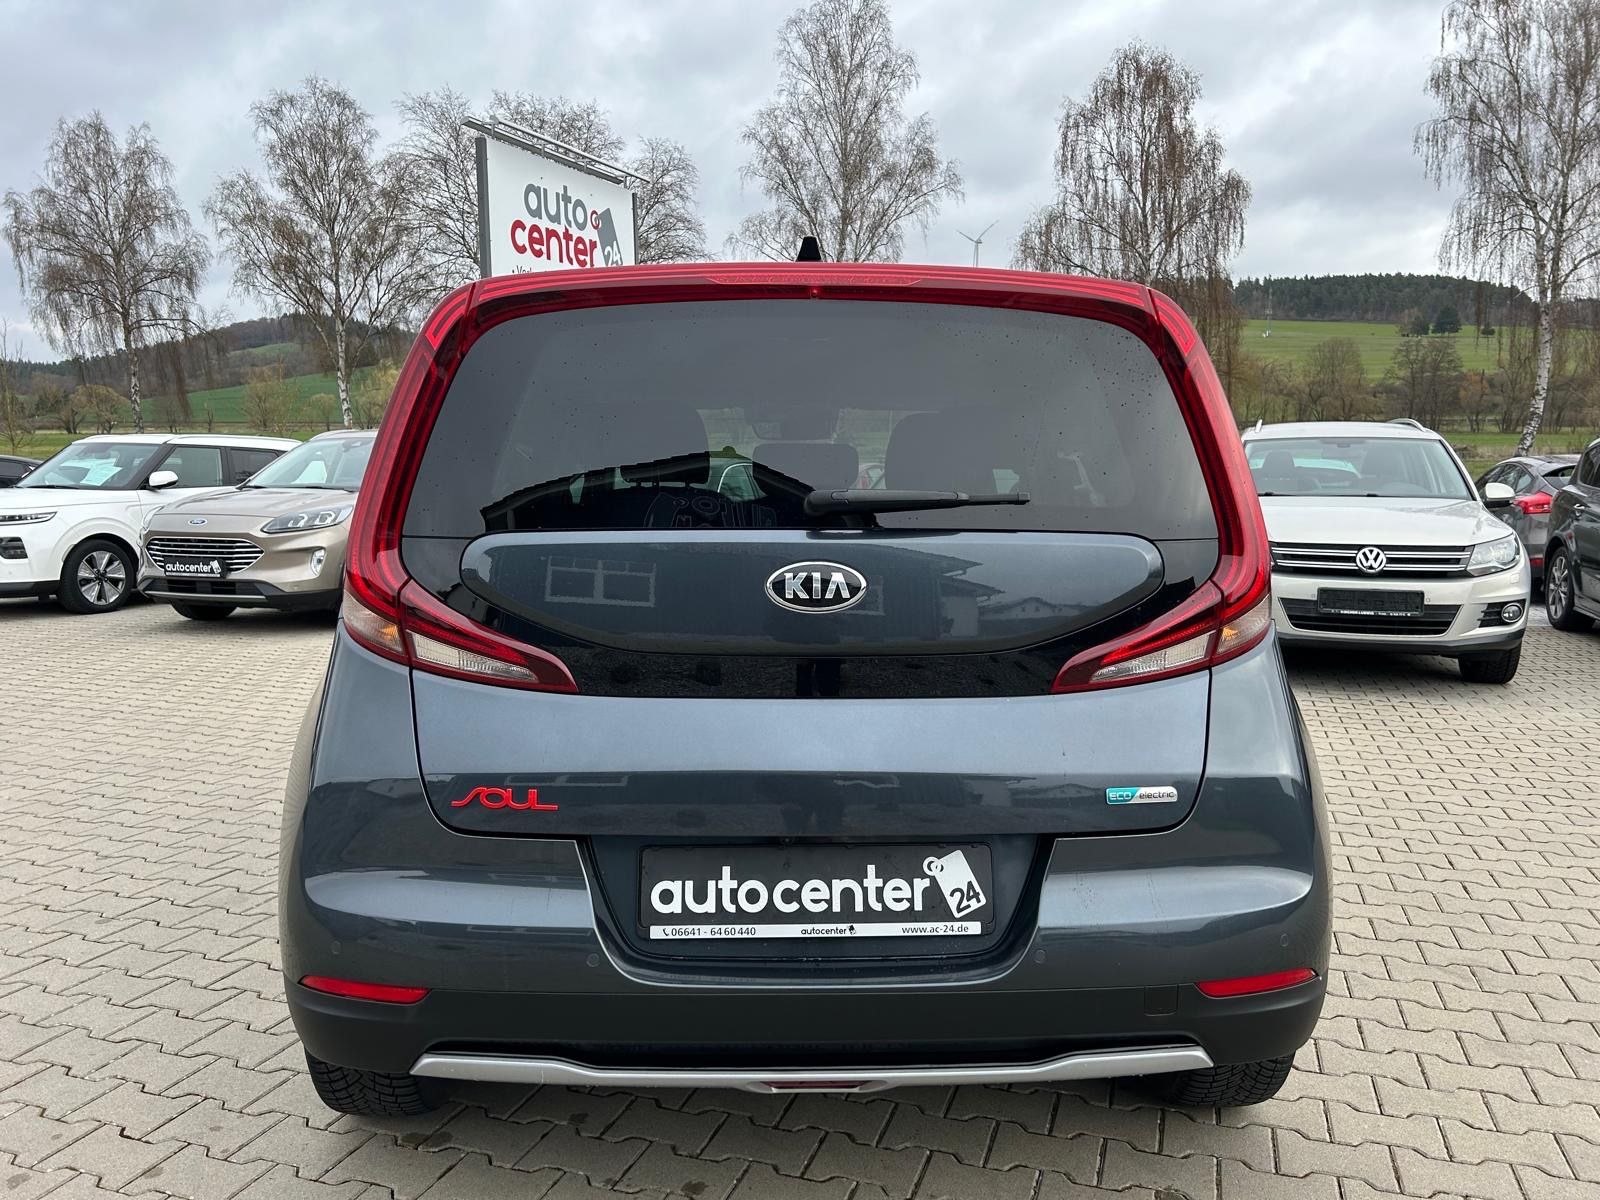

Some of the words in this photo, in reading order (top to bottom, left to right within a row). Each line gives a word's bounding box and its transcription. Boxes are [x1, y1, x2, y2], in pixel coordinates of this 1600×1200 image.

[524, 183, 588, 231] auto
[510, 219, 598, 268] center
[783, 571, 851, 599] KIA
[1109, 791, 1132, 800] ECO
[1139, 790, 1175, 799] electric
[950, 880, 982, 914] 24
[671, 927, 701, 937] 06641
[800, 927, 847, 935] autocenter
[901, 925, 969, 934] www.ac-24.de
